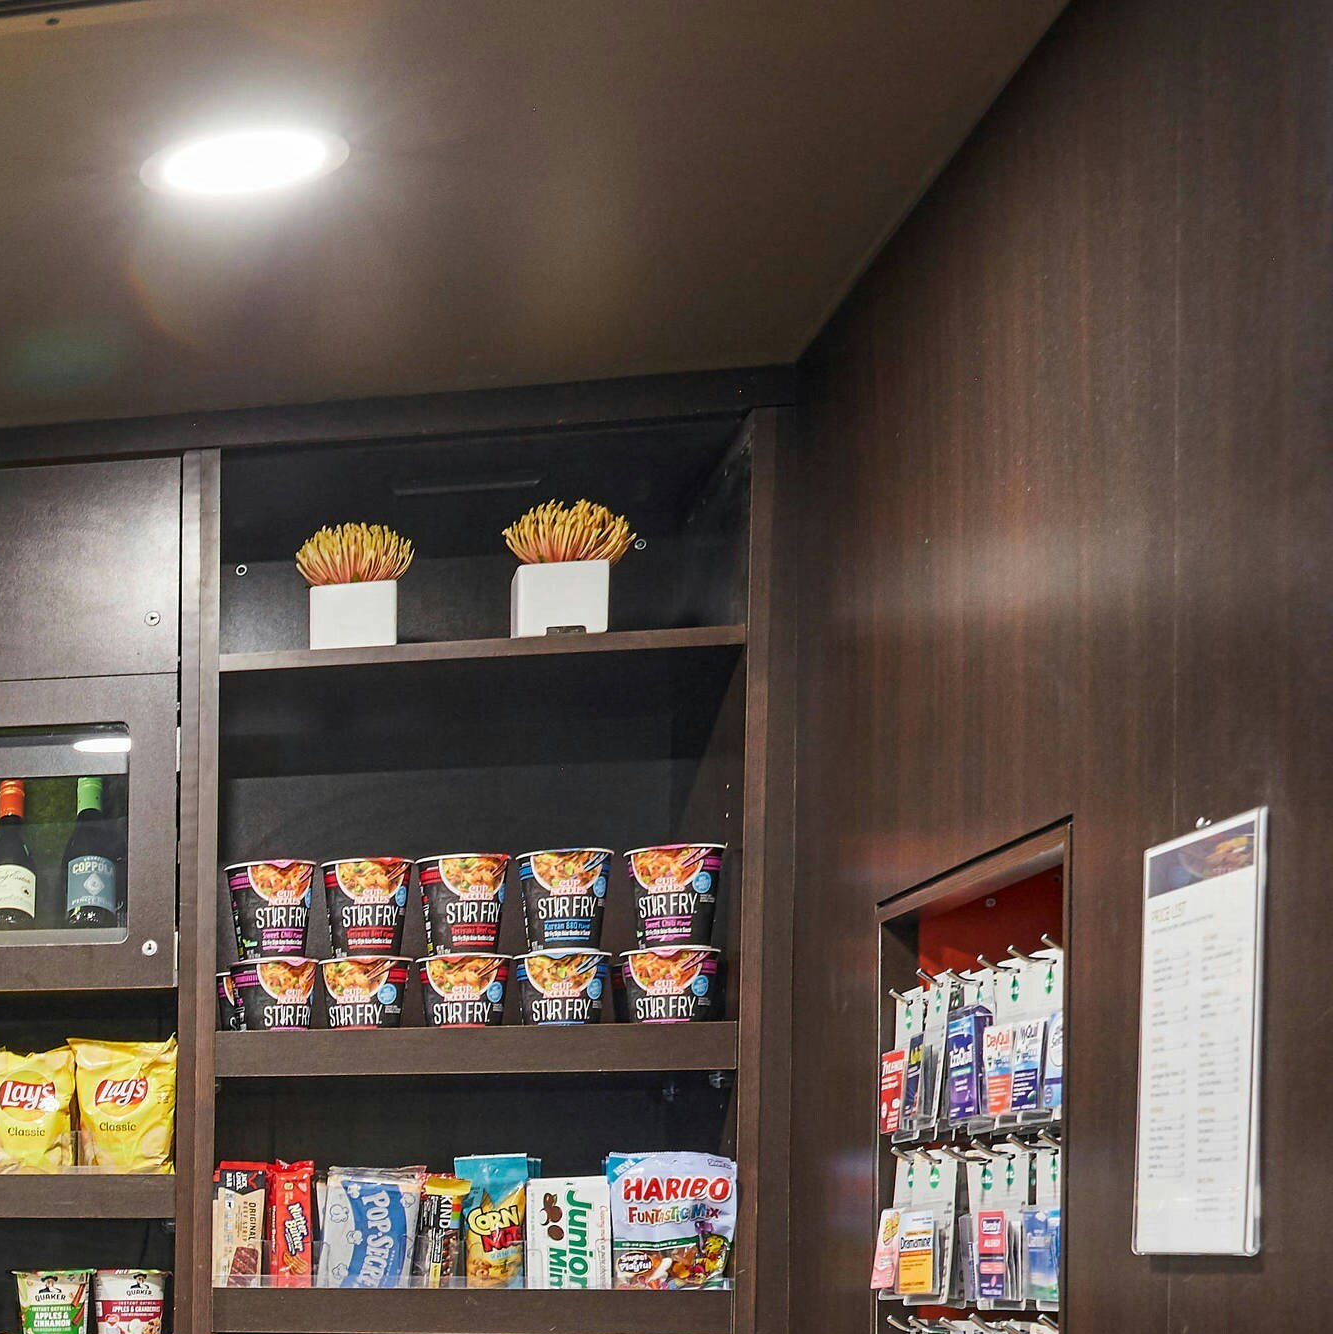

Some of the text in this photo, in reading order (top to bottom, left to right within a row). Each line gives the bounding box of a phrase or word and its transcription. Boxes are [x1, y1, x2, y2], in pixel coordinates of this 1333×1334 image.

[255, 906, 308, 928] STIR FRY
[342, 905, 398, 928] STIR FRY
[446, 902, 501, 925] STIR FRY
[538, 895, 595, 919] STIR FRY
[639, 893, 696, 919] STIR FRY
[544, 922, 565, 931] Korean
[264, 1005, 311, 1027] STIR FRY
[329, 1003, 382, 1027] STIR FRY
[434, 1001, 490, 1025] STIR FRY
[533, 999, 590, 1021] STIR FRY
[636, 996, 695, 1019] STIR FRY
[986, 1029, 1010, 1048] DayQuil
[0, 1080, 56, 1111] Lay's
[95, 1076, 148, 1106] Lay's
[7, 1126, 46, 1138] Classic
[99, 1121, 137, 1133] Classic
[623, 1177, 731, 1203] HARIBO
[248, 1202, 257, 1241] ORIGINAL
[288, 1203, 308, 1237] Nutter
[439, 1195, 453, 1229] KIND
[467, 1205, 521, 1236] CORN
[285, 1220, 304, 1252] Butter
[566, 1189, 593, 1289] Junior
[900, 1236, 932, 1249] Dramamine
[549, 1247, 567, 1290] Min
[619, 1261, 652, 1272] Playful
[620, 1253, 648, 1262] Sweet
[34, 1293, 66, 1301] QUAKER
[126, 1288, 152, 1297] QUAKER
[33, 1319, 71, 1328] CINNAMON
[34, 1312, 69, 1320] APPLES &
